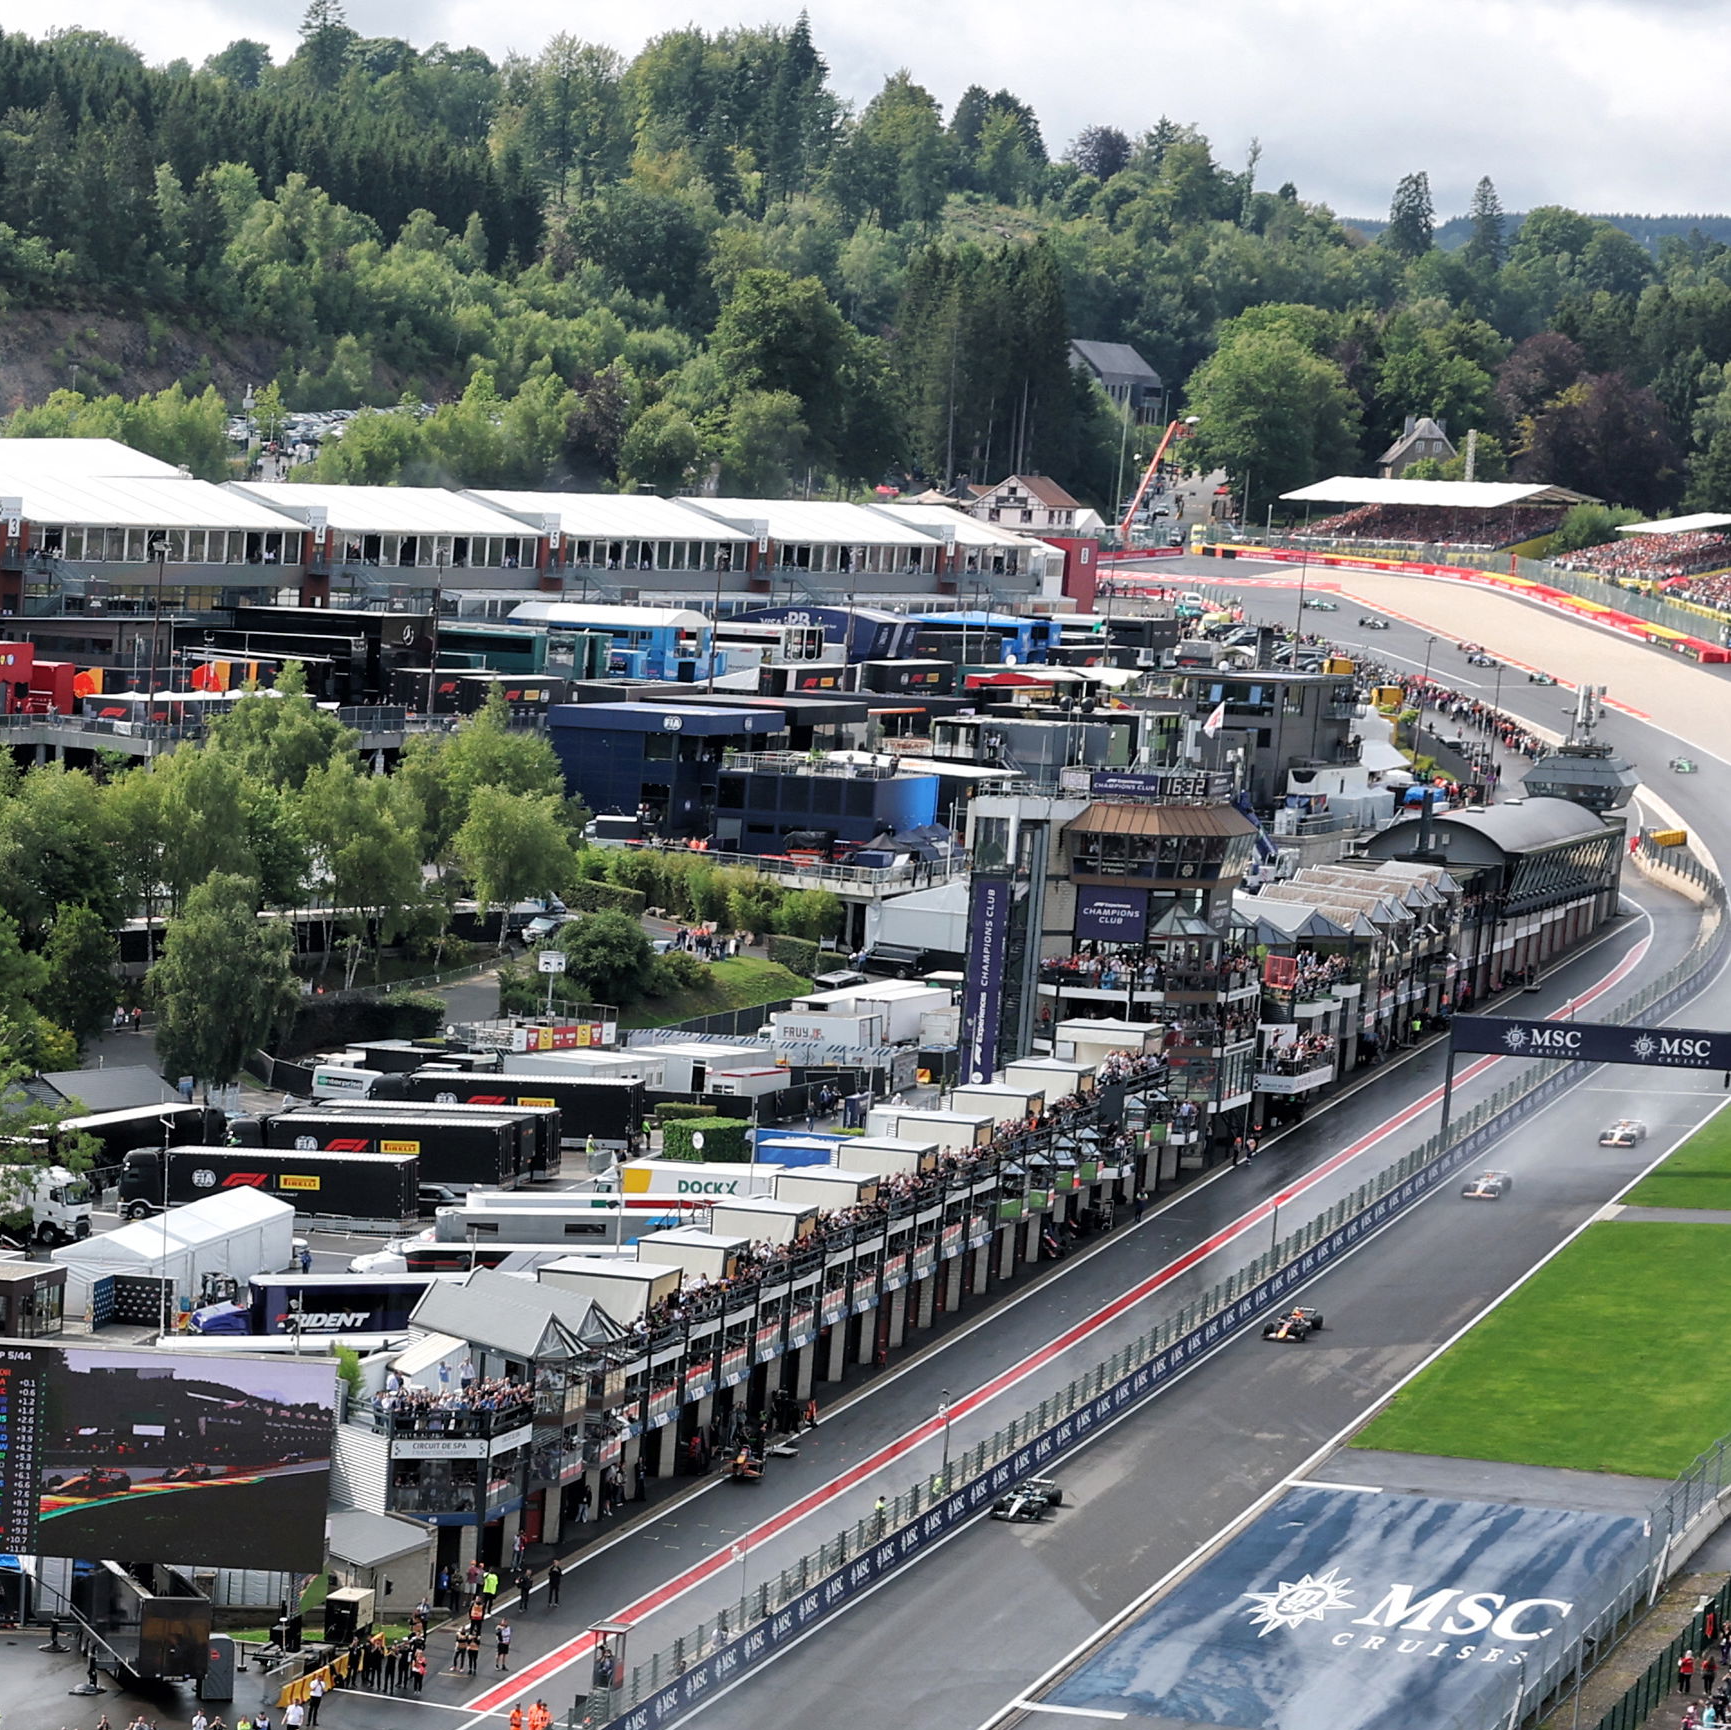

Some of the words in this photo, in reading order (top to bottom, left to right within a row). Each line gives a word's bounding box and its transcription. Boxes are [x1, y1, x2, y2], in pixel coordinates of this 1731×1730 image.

[12, 518, 18, 536] 3
[665, 718, 682, 730] FIA
[1094, 782, 1137, 791] CHAMPIONS
[1139, 784, 1155, 792] CLUB
[1166, 777, 1205, 796] 16:32
[986, 889, 996, 918] CLUB
[1083, 908, 1140, 918] CHAMPIONS
[981, 920, 995, 987] CHAMPIONS
[976, 991, 987, 1044] Experiences
[783, 1027, 808, 1038] FRUY
[1531, 1028, 1582, 1048] MSC
[1529, 1047, 1580, 1056] CRUISES
[1659, 1037, 1711, 1057] MSC
[1658, 1056, 1710, 1065] CRUISES
[319, 1077, 363, 1090] enterprise
[296, 1138, 317, 1151] FIA
[384, 1142, 417, 1153] PIRELLI
[193, 1171, 216, 1185] FIA
[282, 1178, 317, 1189] PIRELLI
[678, 1180, 738, 1194] DOCKX
[8, 1351, 32, 1361] 5/44
[20, 1380, 36, 1388] +0.1
[18, 1398, 35, 1406] +1.2
[16, 1435, 33, 1443] +3.9
[16, 1444, 32, 1452] +4.2
[1040, 1436, 1051, 1455] MSC
[1019, 1450, 1030, 1469] MSC
[997, 1465, 1009, 1484] MSC
[976, 1479, 988, 1500] MSC
[953, 1495, 965, 1516] MSC
[930, 1510, 943, 1531] MSC
[906, 1526, 919, 1547] MSC
[882, 1542, 895, 1563] MSC
[856, 1559, 870, 1580] MSC
[830, 1575, 844, 1596] MSC
[804, 1593, 819, 1614] MSC
[1351, 1583, 1573, 1641] MSC
[777, 1611, 792, 1634] MSC
[750, 1630, 765, 1653] MSC
[1332, 1632, 1529, 1666] CRUISES
[721, 1649, 737, 1672] MSC
[692, 1668, 708, 1692] MSC
[662, 1688, 678, 1711] MSC
